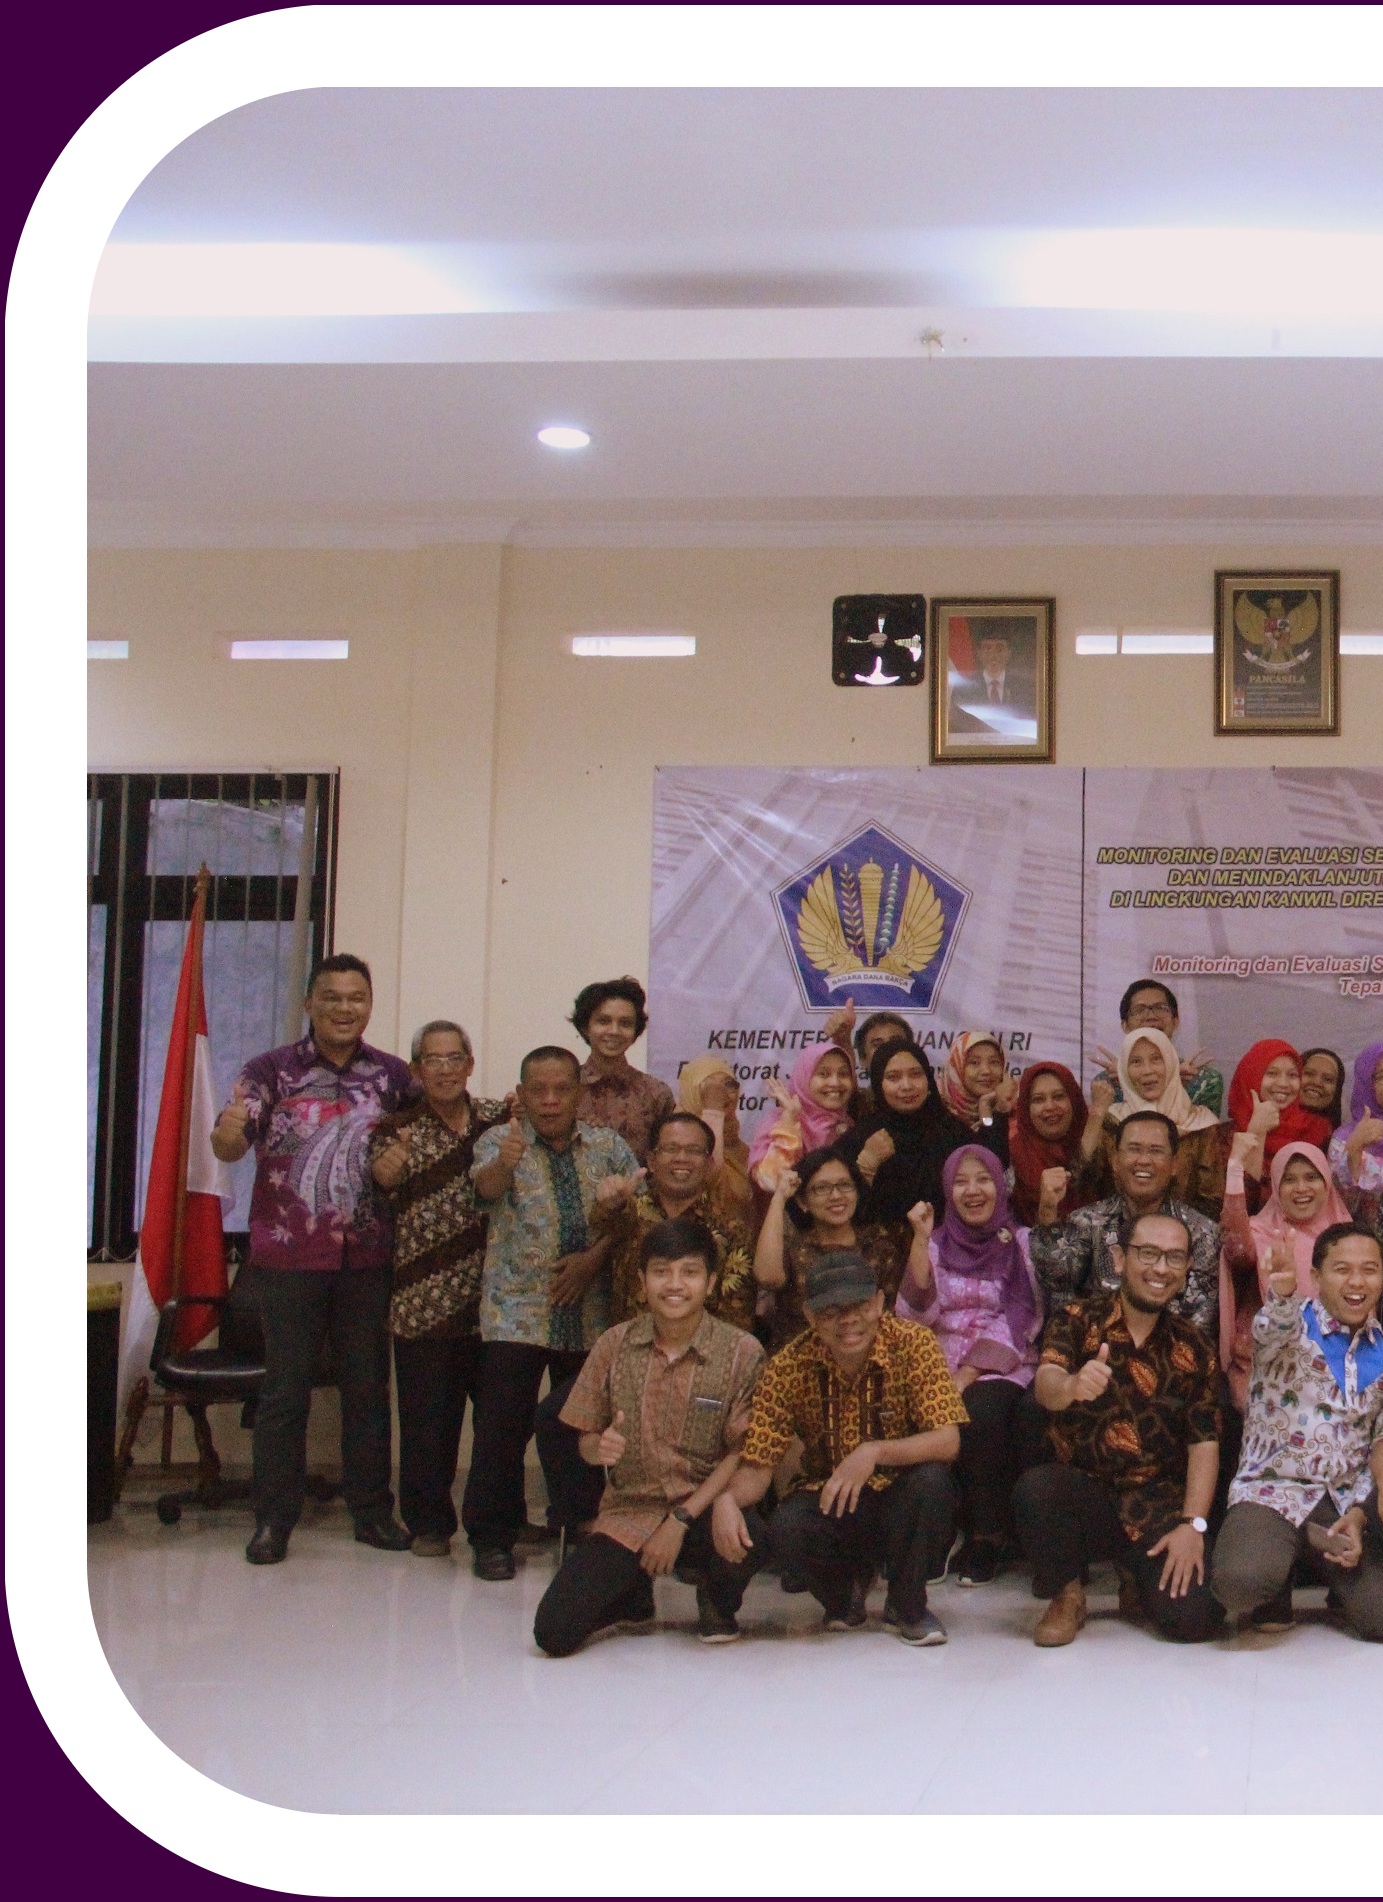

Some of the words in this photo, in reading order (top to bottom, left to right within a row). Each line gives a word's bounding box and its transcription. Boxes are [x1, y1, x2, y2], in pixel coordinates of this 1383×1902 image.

[1249, 674, 1306, 684] PANCASILA
[1097, 847, 1218, 865] MONITORING
[1220, 847, 1263, 865] DAN
[1265, 847, 1359, 865] EVALUASI
[1167, 869, 1210, 887] DAN
[1110, 890, 1132, 908] DI
[1133, 890, 1260, 908] LINGKUNGAN
[1262, 890, 1338, 908] KANWIL
[1153, 955, 1250, 977] Monitoring
[1252, 955, 1289, 974] dan
[1291, 955, 1370, 974] Evaluasi
[863, 973, 884, 981] DANA
[708, 1030, 830, 1049] KEMENTER
[1009, 1031, 1032, 1051] RI
